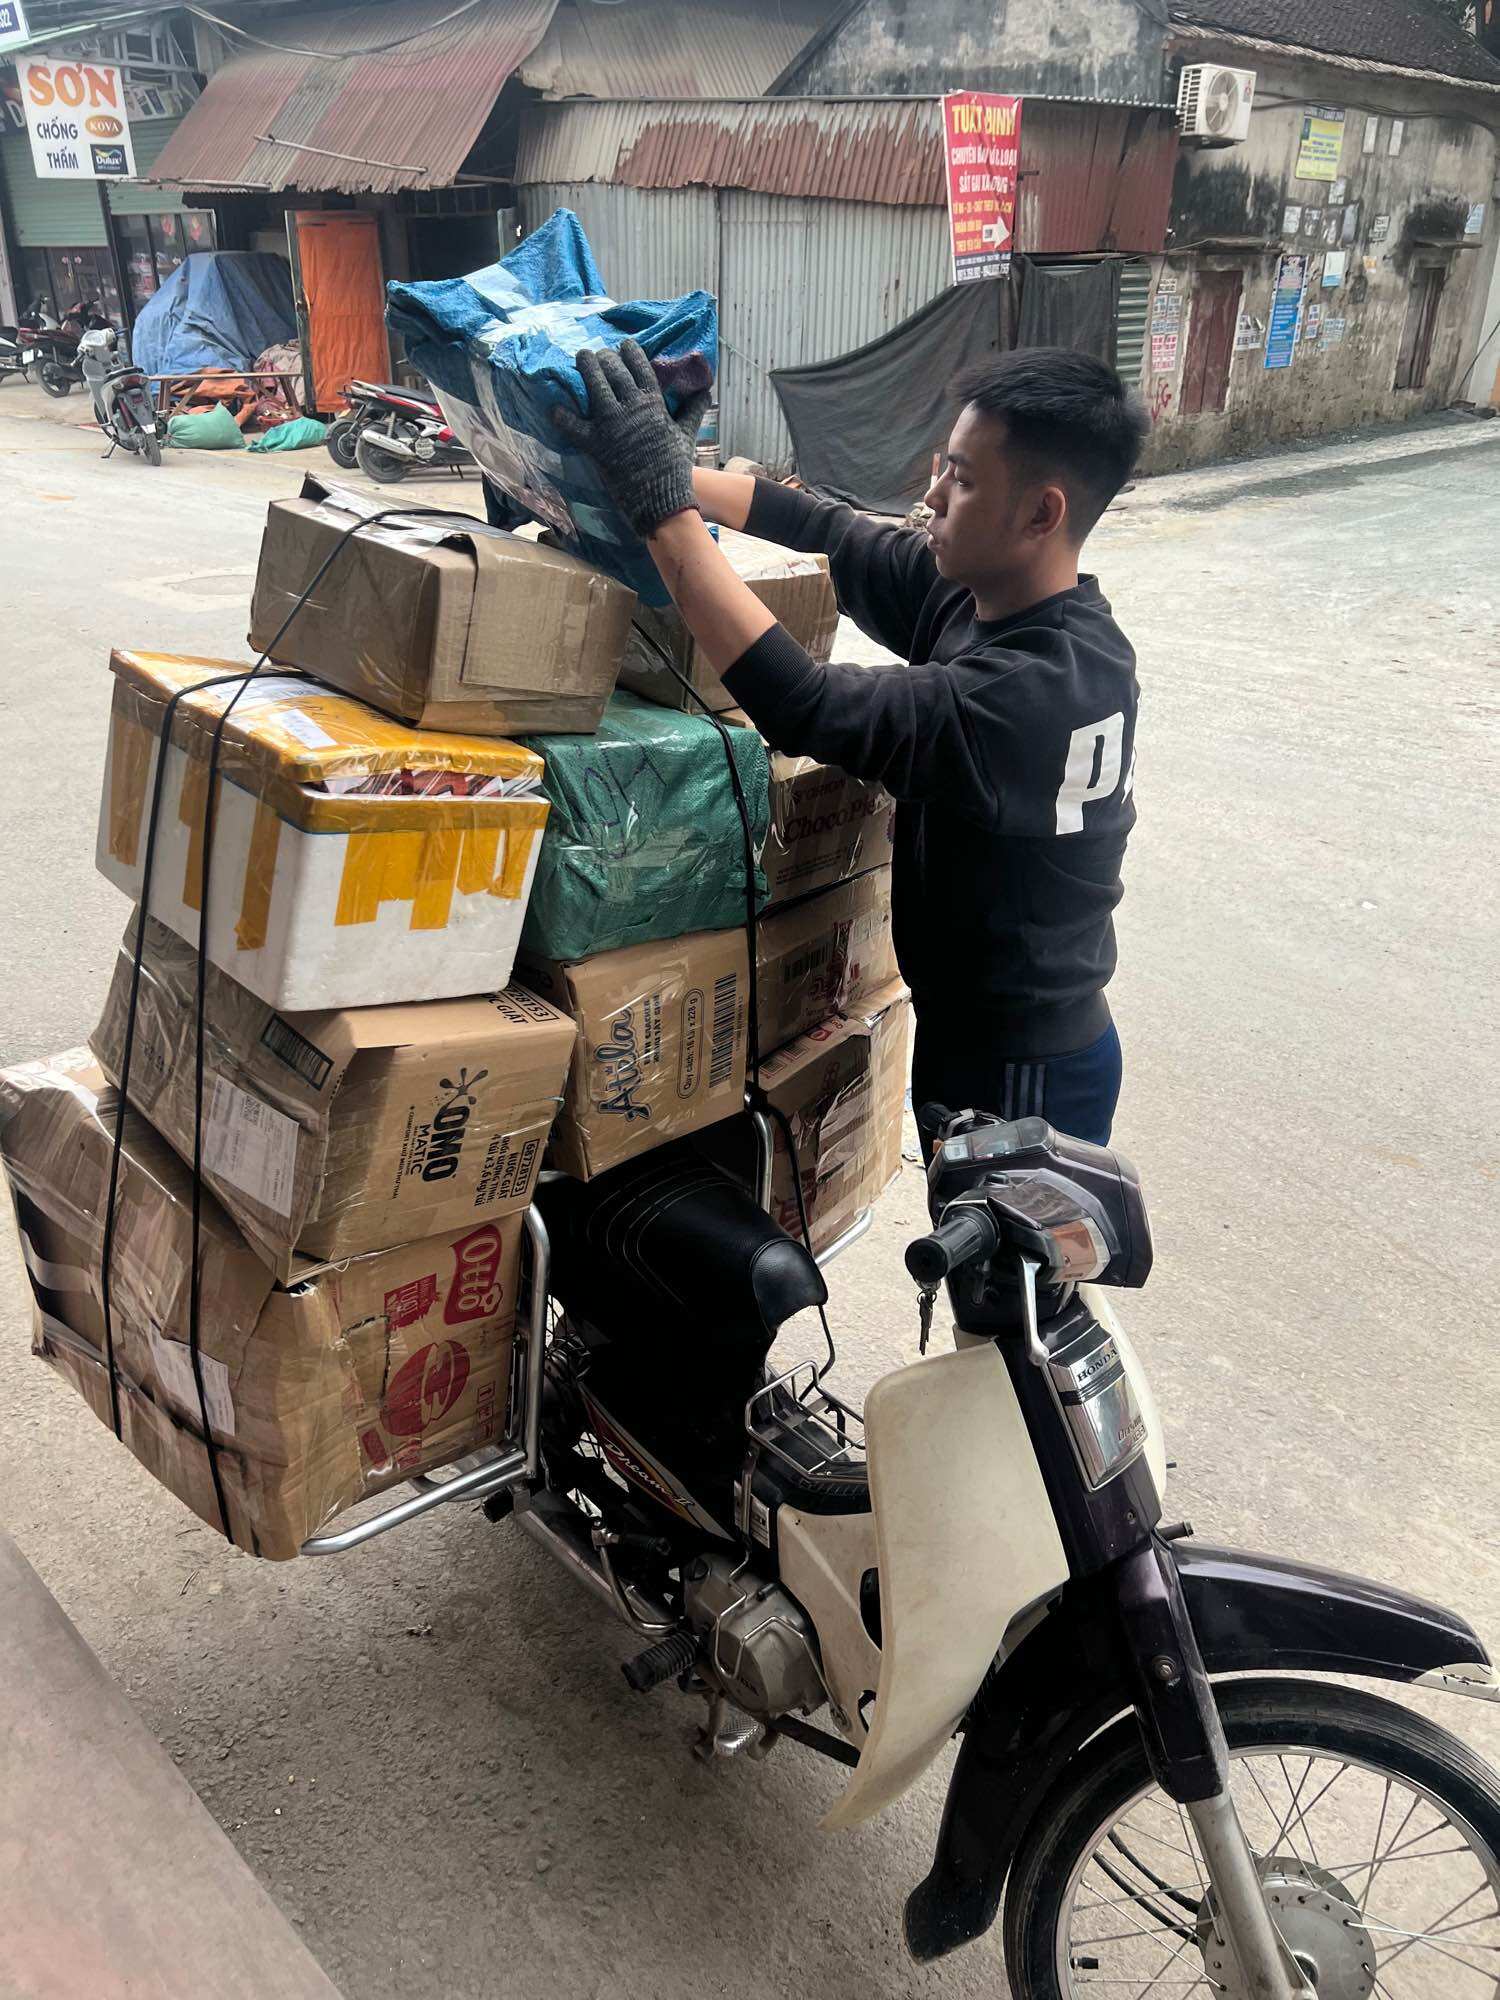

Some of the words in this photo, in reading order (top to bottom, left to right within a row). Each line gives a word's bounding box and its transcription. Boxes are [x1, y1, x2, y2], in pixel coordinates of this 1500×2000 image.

[27, 63, 117, 108] SƠN
[37, 116, 78, 139] CHỐNG
[90, 120, 119, 132] KOVA
[47, 146, 79, 169] THẤM
[96, 156, 121, 165] Dulux
[1056, 711, 1138, 835] P
[503, 985, 549, 1017] 728153
[410, 1124, 432, 1176] MATIC
[422, 1106, 470, 1182] OMO
[488, 1141, 499, 1155] túi
[504, 1151, 521, 1178] NƯỚC
[514, 1143, 536, 1192] 68728153
[497, 1179, 510, 1200] GIẶT
[459, 1237, 498, 1311] Otto
[1077, 1349, 1118, 1382] HONDA
[603, 1436, 673, 1496] Dream
